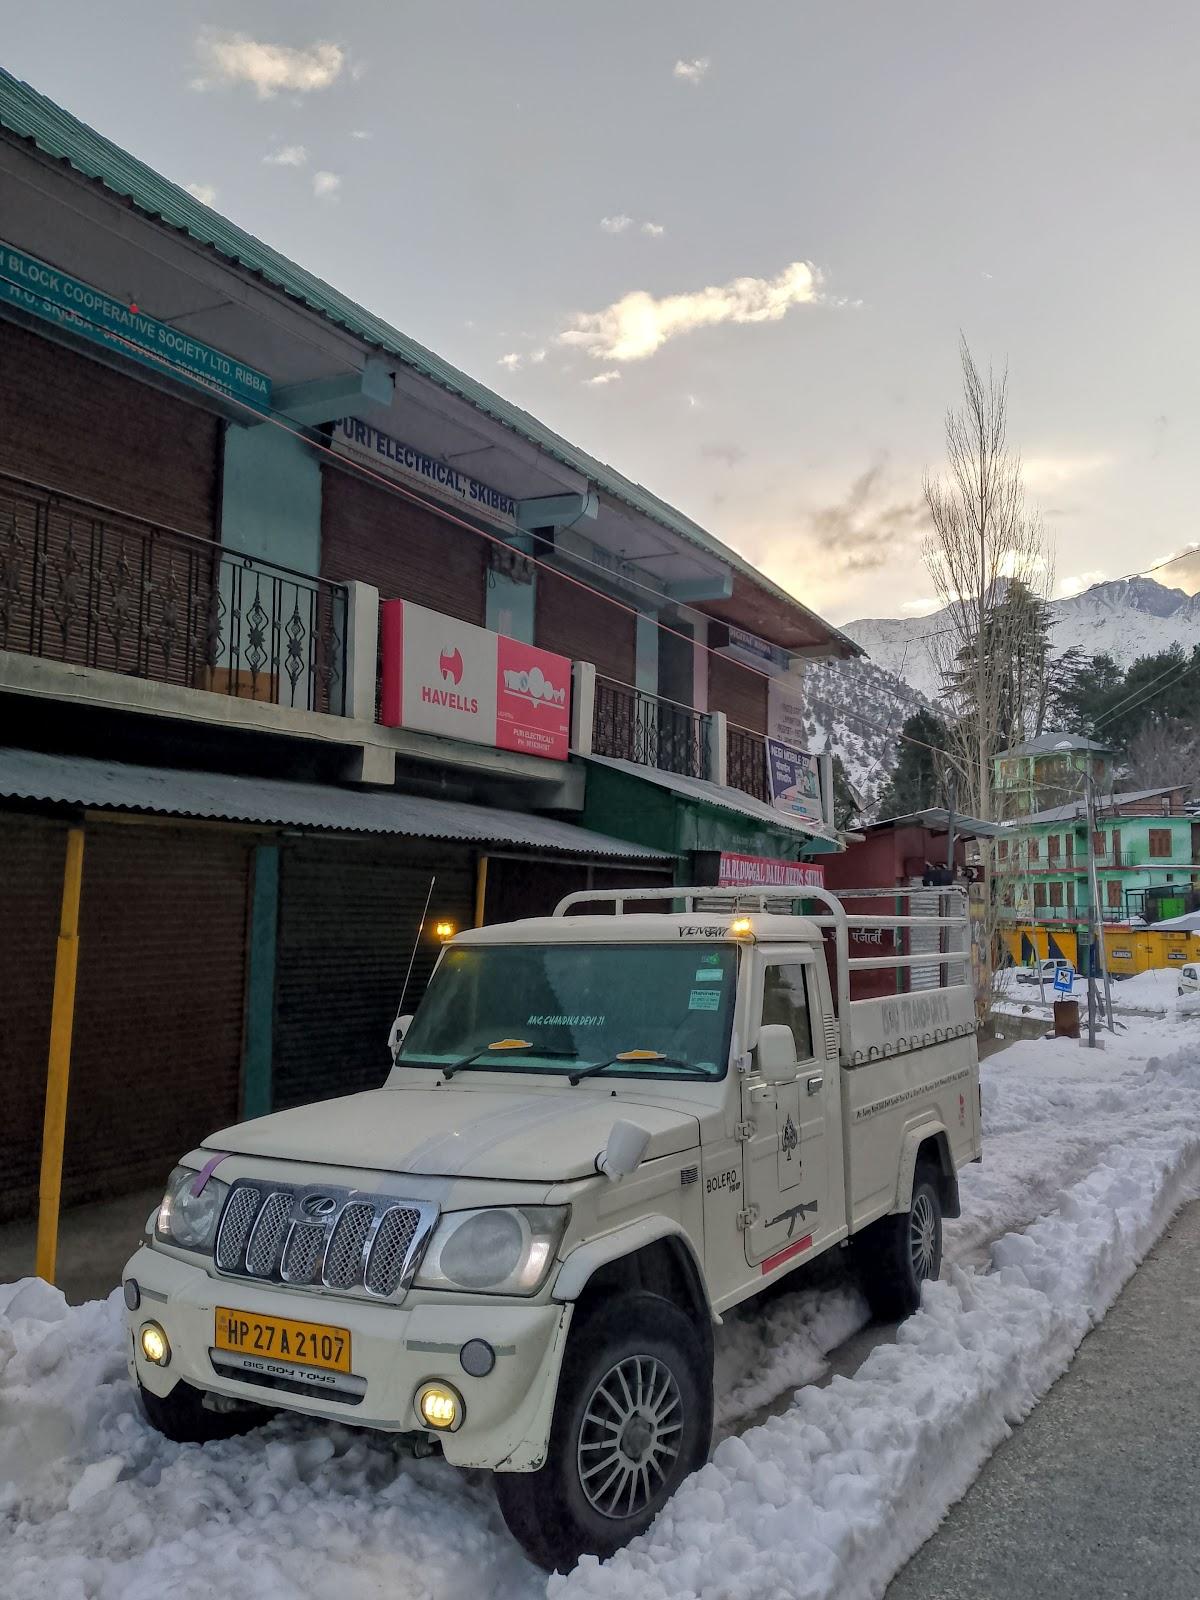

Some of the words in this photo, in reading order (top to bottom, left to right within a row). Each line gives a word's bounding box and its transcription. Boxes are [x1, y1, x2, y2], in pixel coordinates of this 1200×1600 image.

[8, 254, 59, 292] BLOCK
[63, 282, 155, 338] COOPERATIVE
[158, 329, 208, 363] SOCIETY
[210, 355, 232, 377] LTD.
[235, 367, 268, 394] RIBBA
[469, 479, 516, 518] SKIBBA
[421, 686, 479, 714] HAVELLS
[579, 1015, 597, 1025] DEVI
[706, 1169, 737, 1193] BOLERO
[228, 1318, 249, 1346] HP
[253, 1324, 275, 1351] 27
[280, 1328, 290, 1355] A
[295, 1332, 344, 1363] 2107
[243, 1360, 264, 1370] BIG
[267, 1365, 295, 1377] BOY
[298, 1371, 336, 1384] TOYS
